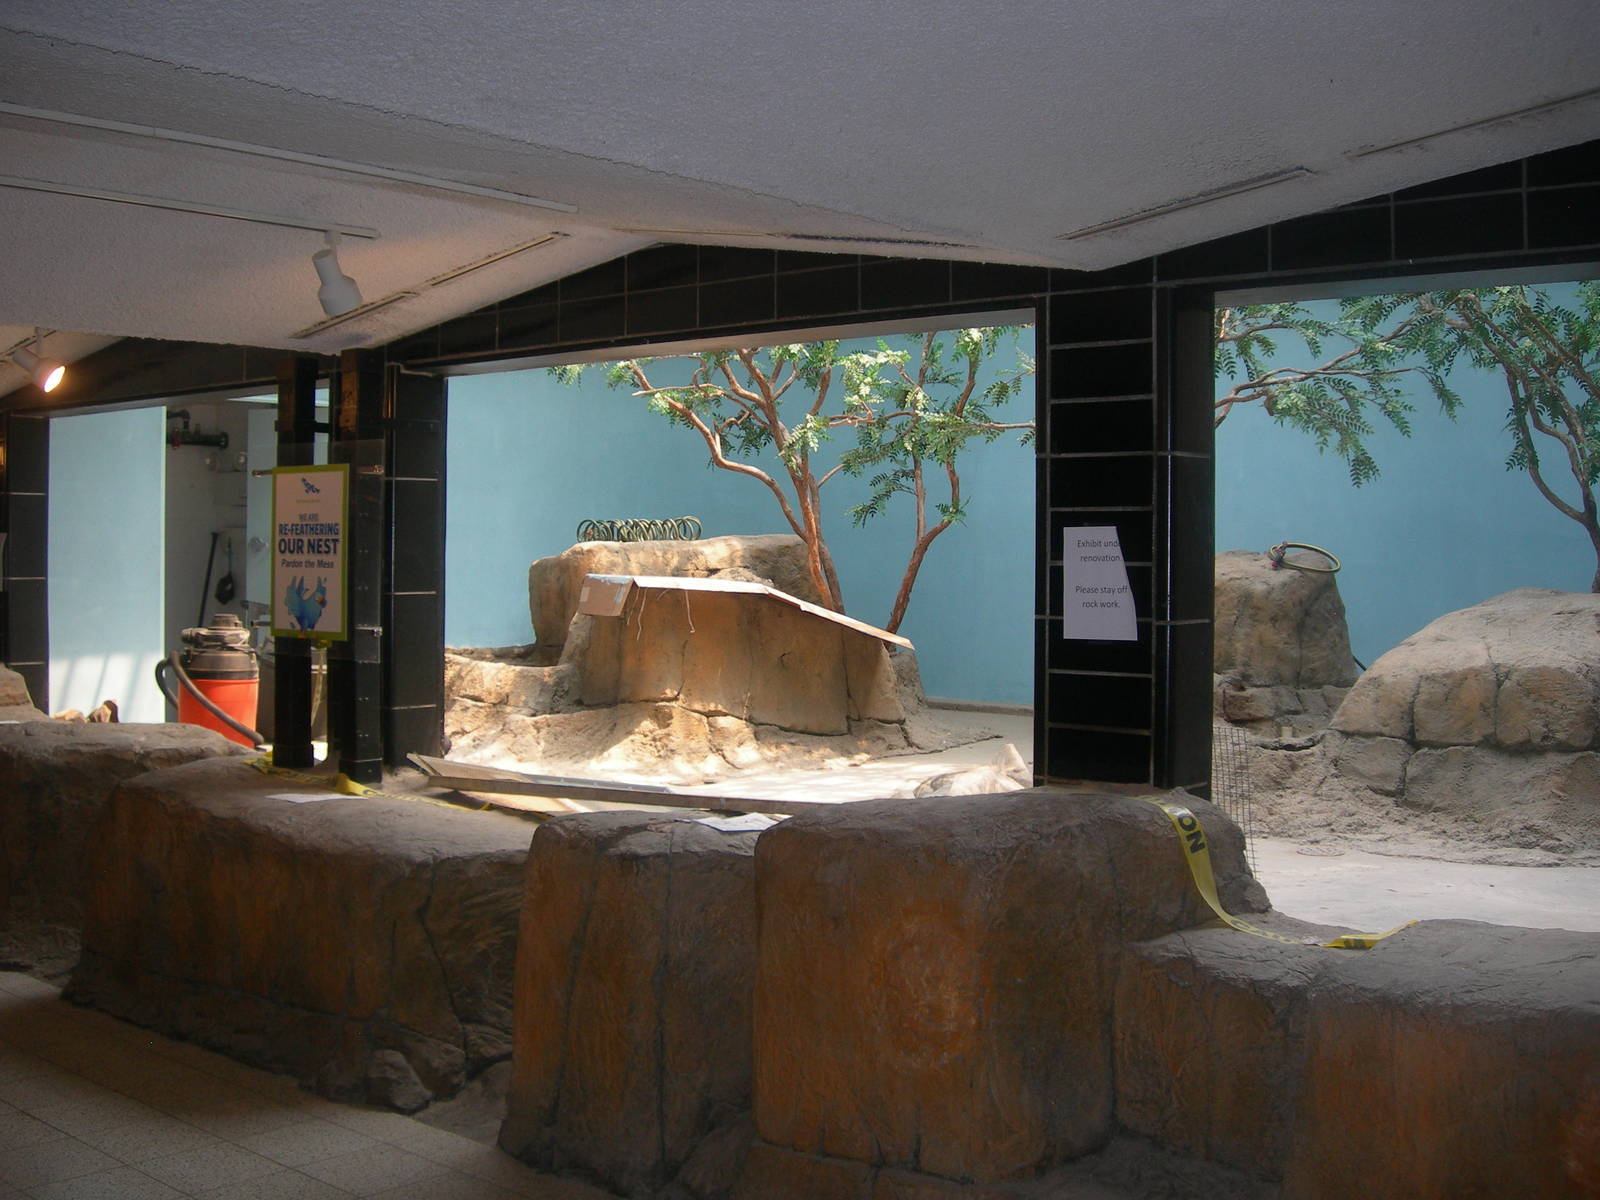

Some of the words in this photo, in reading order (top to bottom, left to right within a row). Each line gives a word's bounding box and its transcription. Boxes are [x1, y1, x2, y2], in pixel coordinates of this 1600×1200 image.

[279, 523, 339, 535] RE-FEATHERING
[279, 538, 304, 554] OUR
[307, 538, 339, 554] NEST
[1077, 539, 1102, 548] Exhibit
[281, 559, 303, 568] Pardon
[304, 559, 315, 568] the
[317, 559, 334, 568] Mess
[1075, 585, 1099, 594] Please
[1100, 586, 1115, 596] stay
[1117, 585, 1129, 594] off
[1082, 600, 1098, 608] rock
